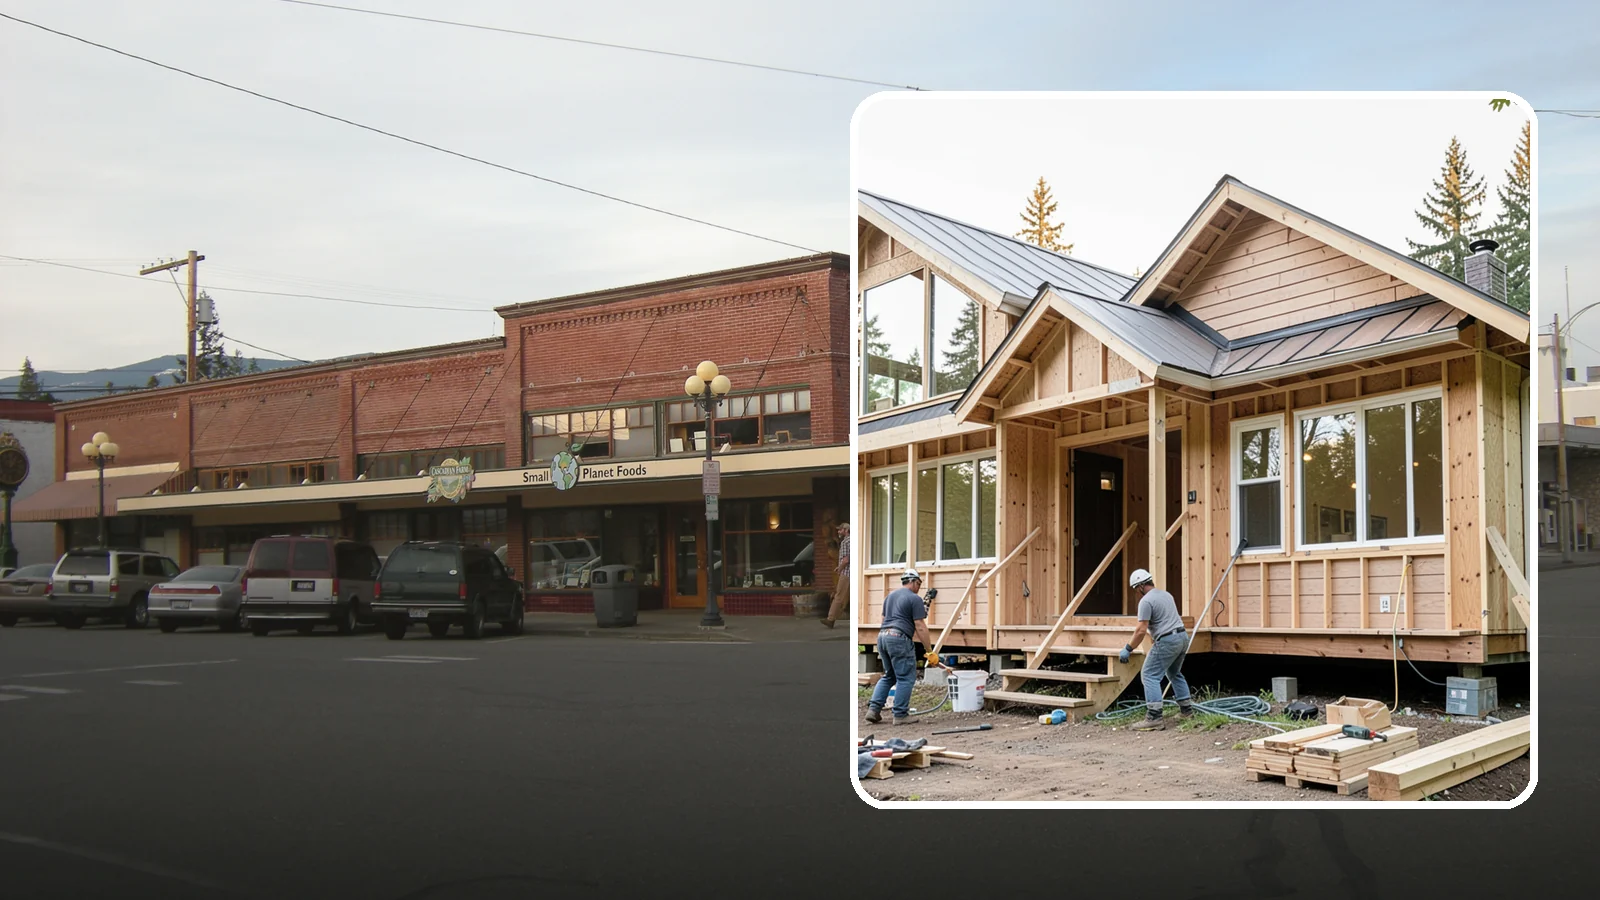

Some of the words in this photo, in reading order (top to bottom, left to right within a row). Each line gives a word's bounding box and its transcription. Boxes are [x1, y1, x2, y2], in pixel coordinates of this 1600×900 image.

[523, 471, 549, 483] Small
[583, 467, 613, 479] Planet
[617, 464, 647, 477] Foods
